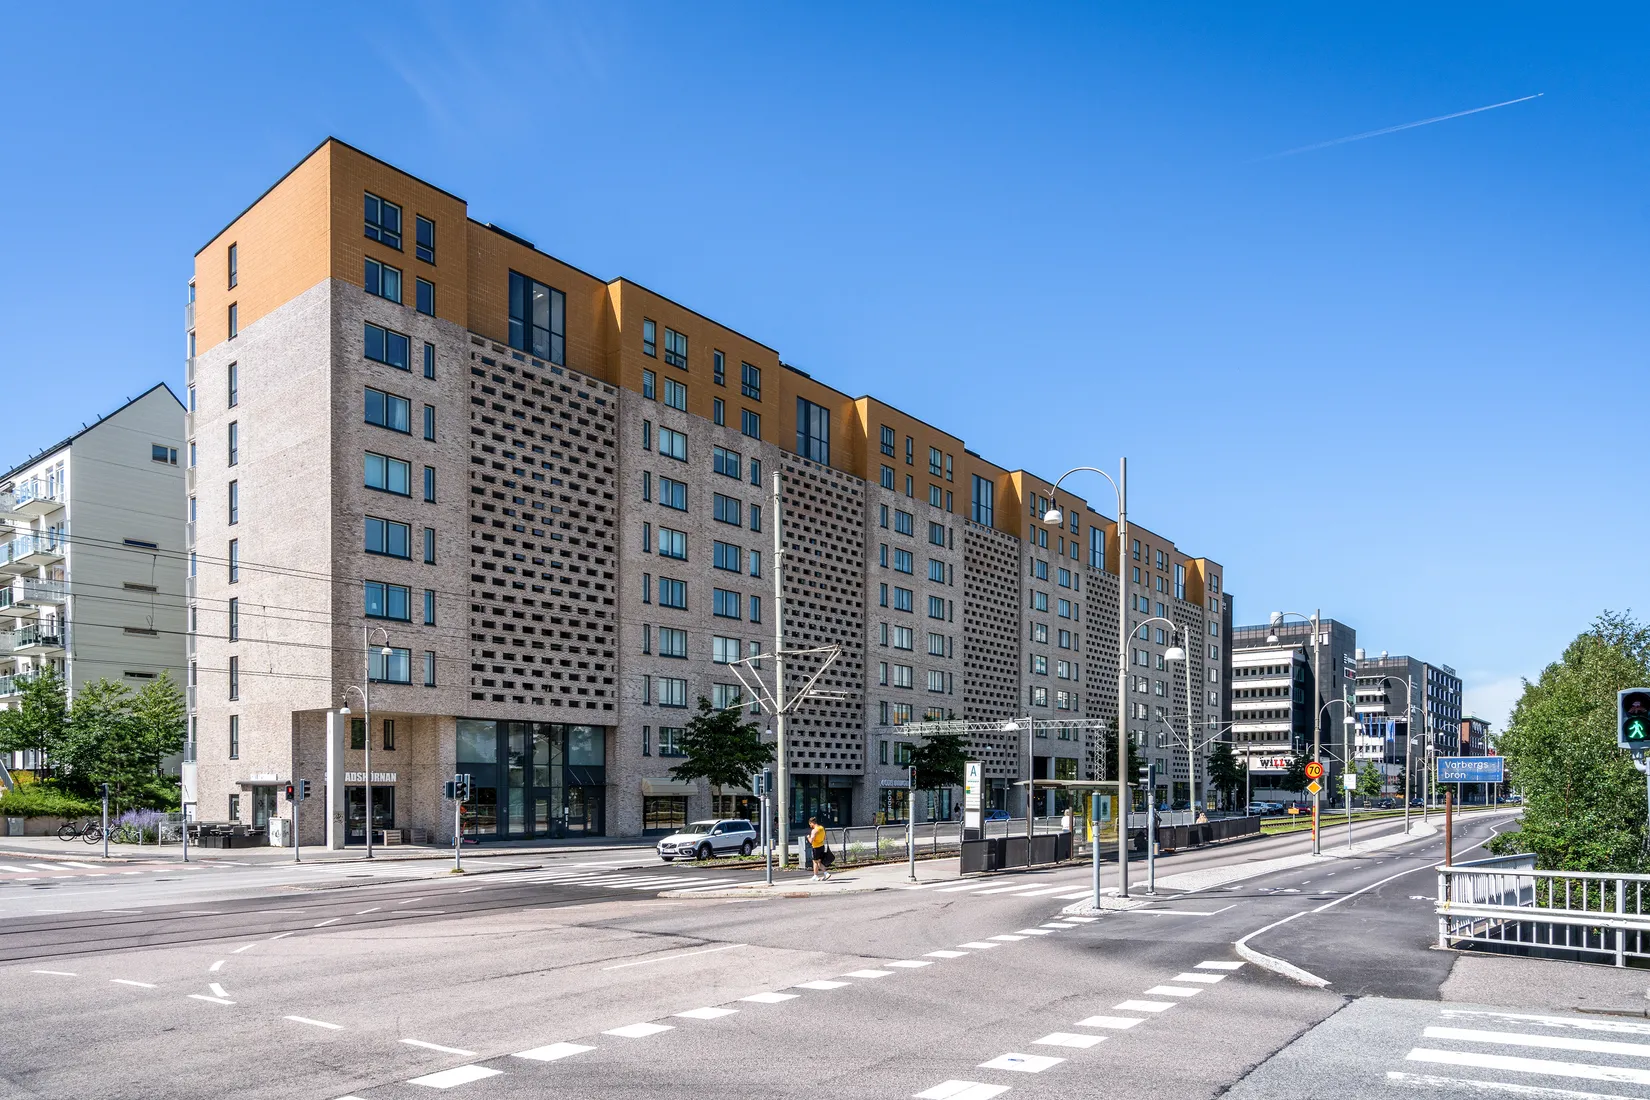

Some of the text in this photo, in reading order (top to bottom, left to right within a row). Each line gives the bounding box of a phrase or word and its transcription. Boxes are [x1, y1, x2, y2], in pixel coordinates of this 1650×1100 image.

[970, 765, 977, 776] A
[1309, 766, 1320, 775] 70
[1445, 771, 1466, 779] bron
